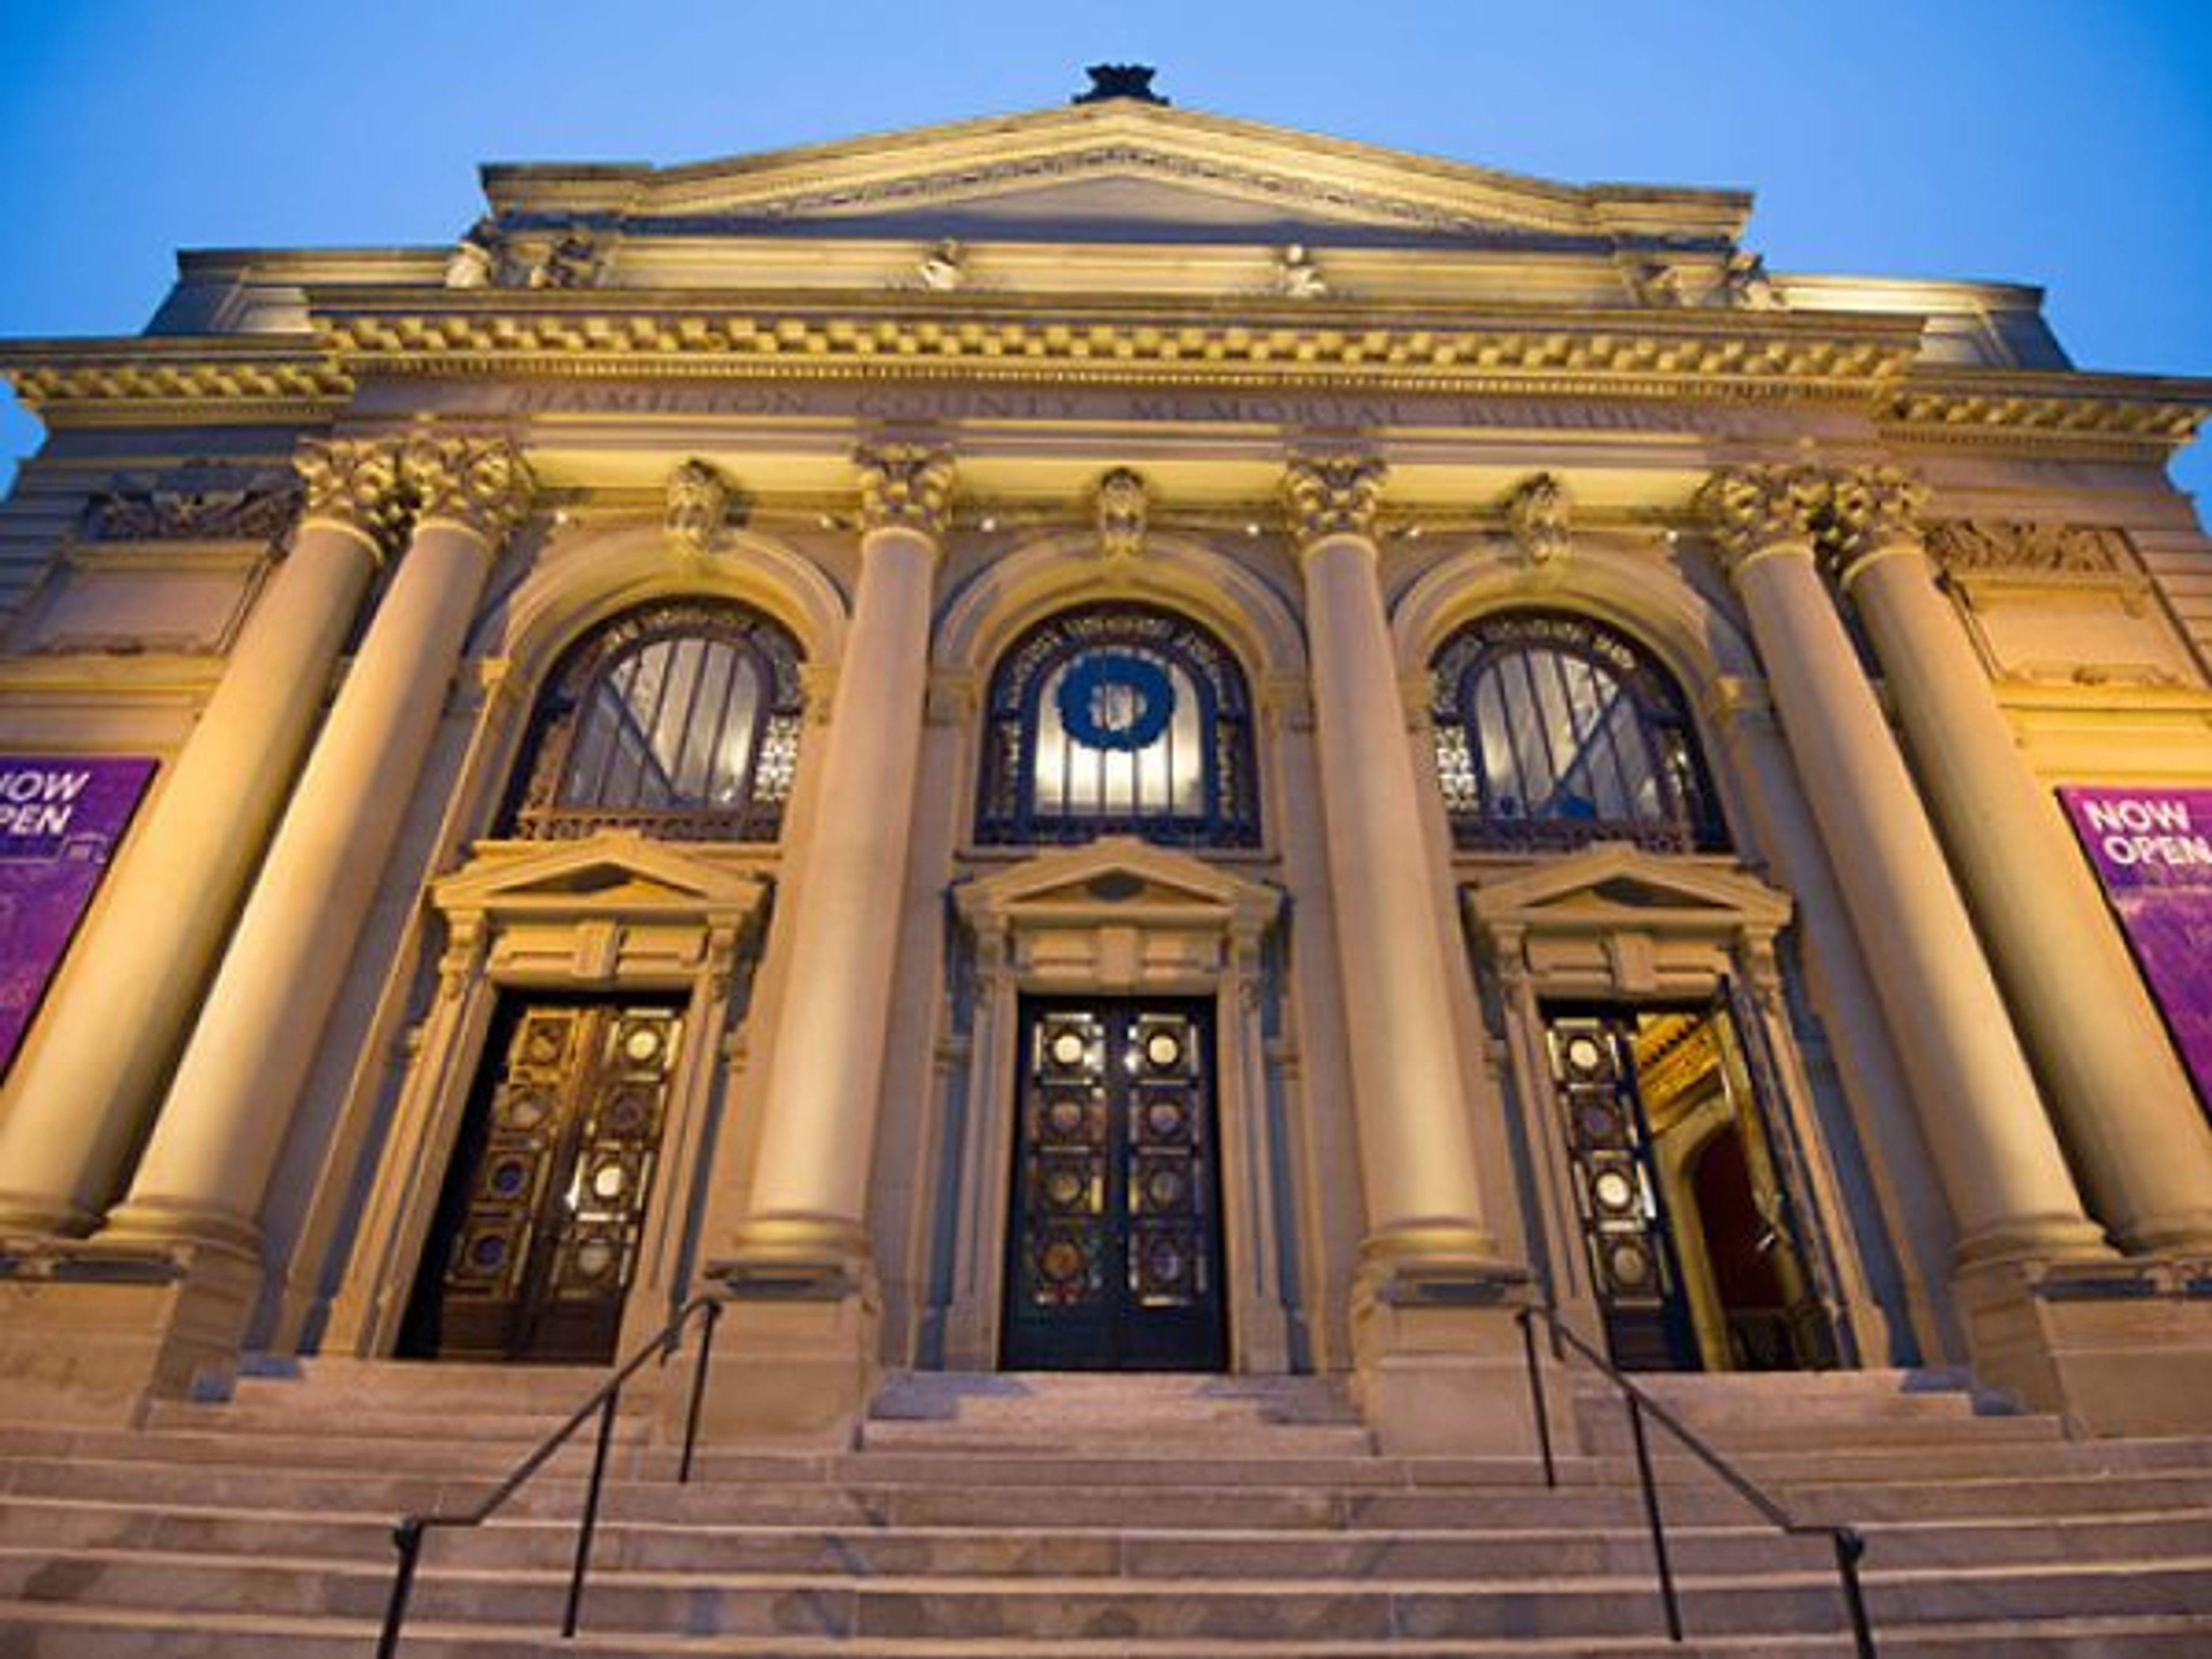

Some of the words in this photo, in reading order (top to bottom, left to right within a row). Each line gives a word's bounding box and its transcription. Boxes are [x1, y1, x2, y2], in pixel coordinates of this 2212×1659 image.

[856, 392, 1082, 418] COUNTY
[1129, 396, 1411, 426] MEMORIAL
[2082, 798, 2190, 831] NOW
